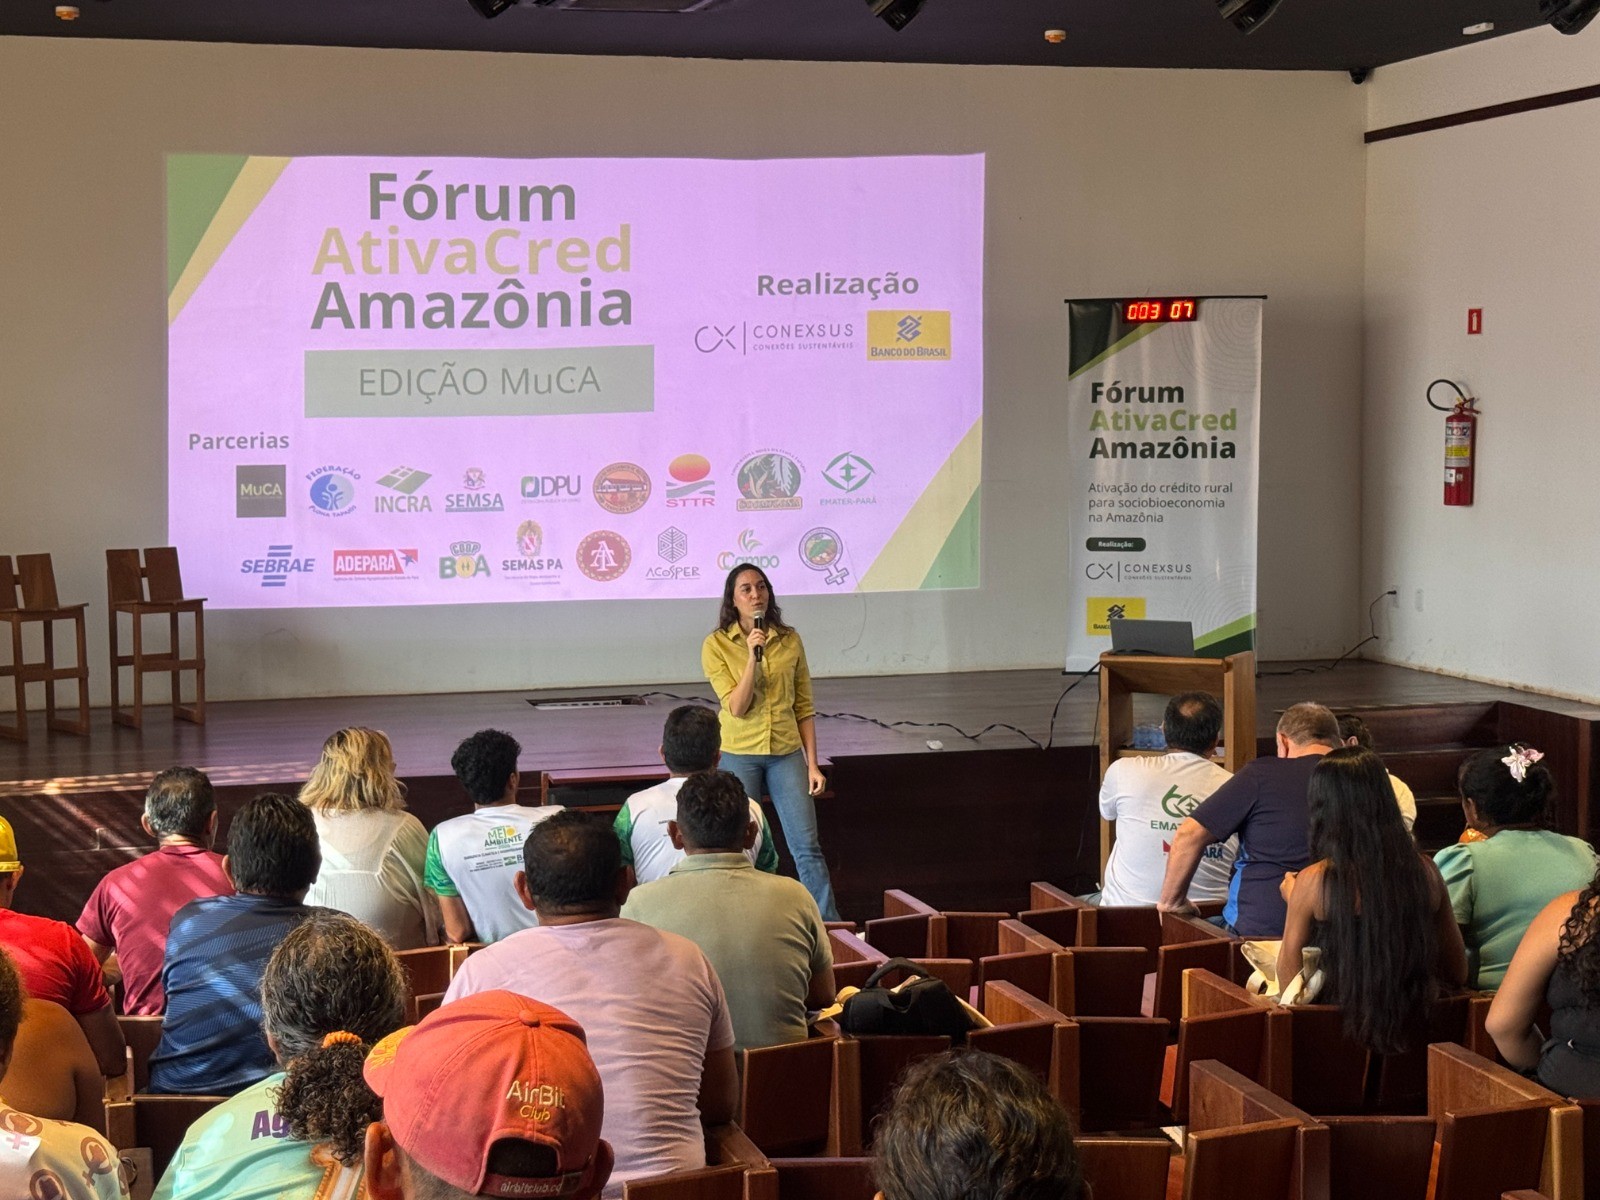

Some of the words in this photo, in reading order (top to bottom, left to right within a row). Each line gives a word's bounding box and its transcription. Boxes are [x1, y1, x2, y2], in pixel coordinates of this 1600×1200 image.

[369, 169, 576, 222] Fórum
[311, 223, 631, 275] AtivaCred
[757, 271, 919, 301] Realização
[310, 277, 632, 329] Amazônia
[753, 323, 853, 339] CONEXSUS
[753, 342, 795, 351] CONEXÕES
[798, 341, 853, 350] SUSTENTÁVEIS
[871, 347, 902, 357] BANCO
[903, 348, 916, 357] DO
[916, 347, 947, 357] BRASIL
[359, 362, 488, 404] EDIÇÃO
[501, 366, 601, 395] MuCA
[1091, 381, 1184, 404] Fórum
[1089, 408, 1237, 432] AtivaCred
[189, 432, 290, 450] Parcerias
[1089, 436, 1236, 459] Amazônia
[541, 475, 581, 496] DPU
[1088, 483, 1138, 496] Ativação
[1141, 483, 1156, 493] do
[1159, 482, 1201, 493] crédito
[1204, 482, 1233, 493] rural
[375, 496, 432, 513] INCRA
[445, 493, 504, 508] SEMSA
[666, 498, 715, 507] STTR
[1088, 499, 1115, 511] para
[1118, 497, 1225, 508] sociobioeconomia
[1088, 514, 1103, 523] na
[1105, 512, 1164, 523] Amazônia
[1098, 541, 1134, 549] Realização:
[240, 558, 316, 573] SEBRAE
[335, 553, 397, 572] ADEPARÁ
[502, 559, 544, 571] SEMAS
[546, 558, 564, 570] PA
[1124, 564, 1192, 573] CONEXSUS
[1150, 820, 1182, 831] EMA
[506, 1080, 566, 1109] AirBit
[519, 1105, 551, 1121] Club
[250, 1109, 291, 1141] Ag
